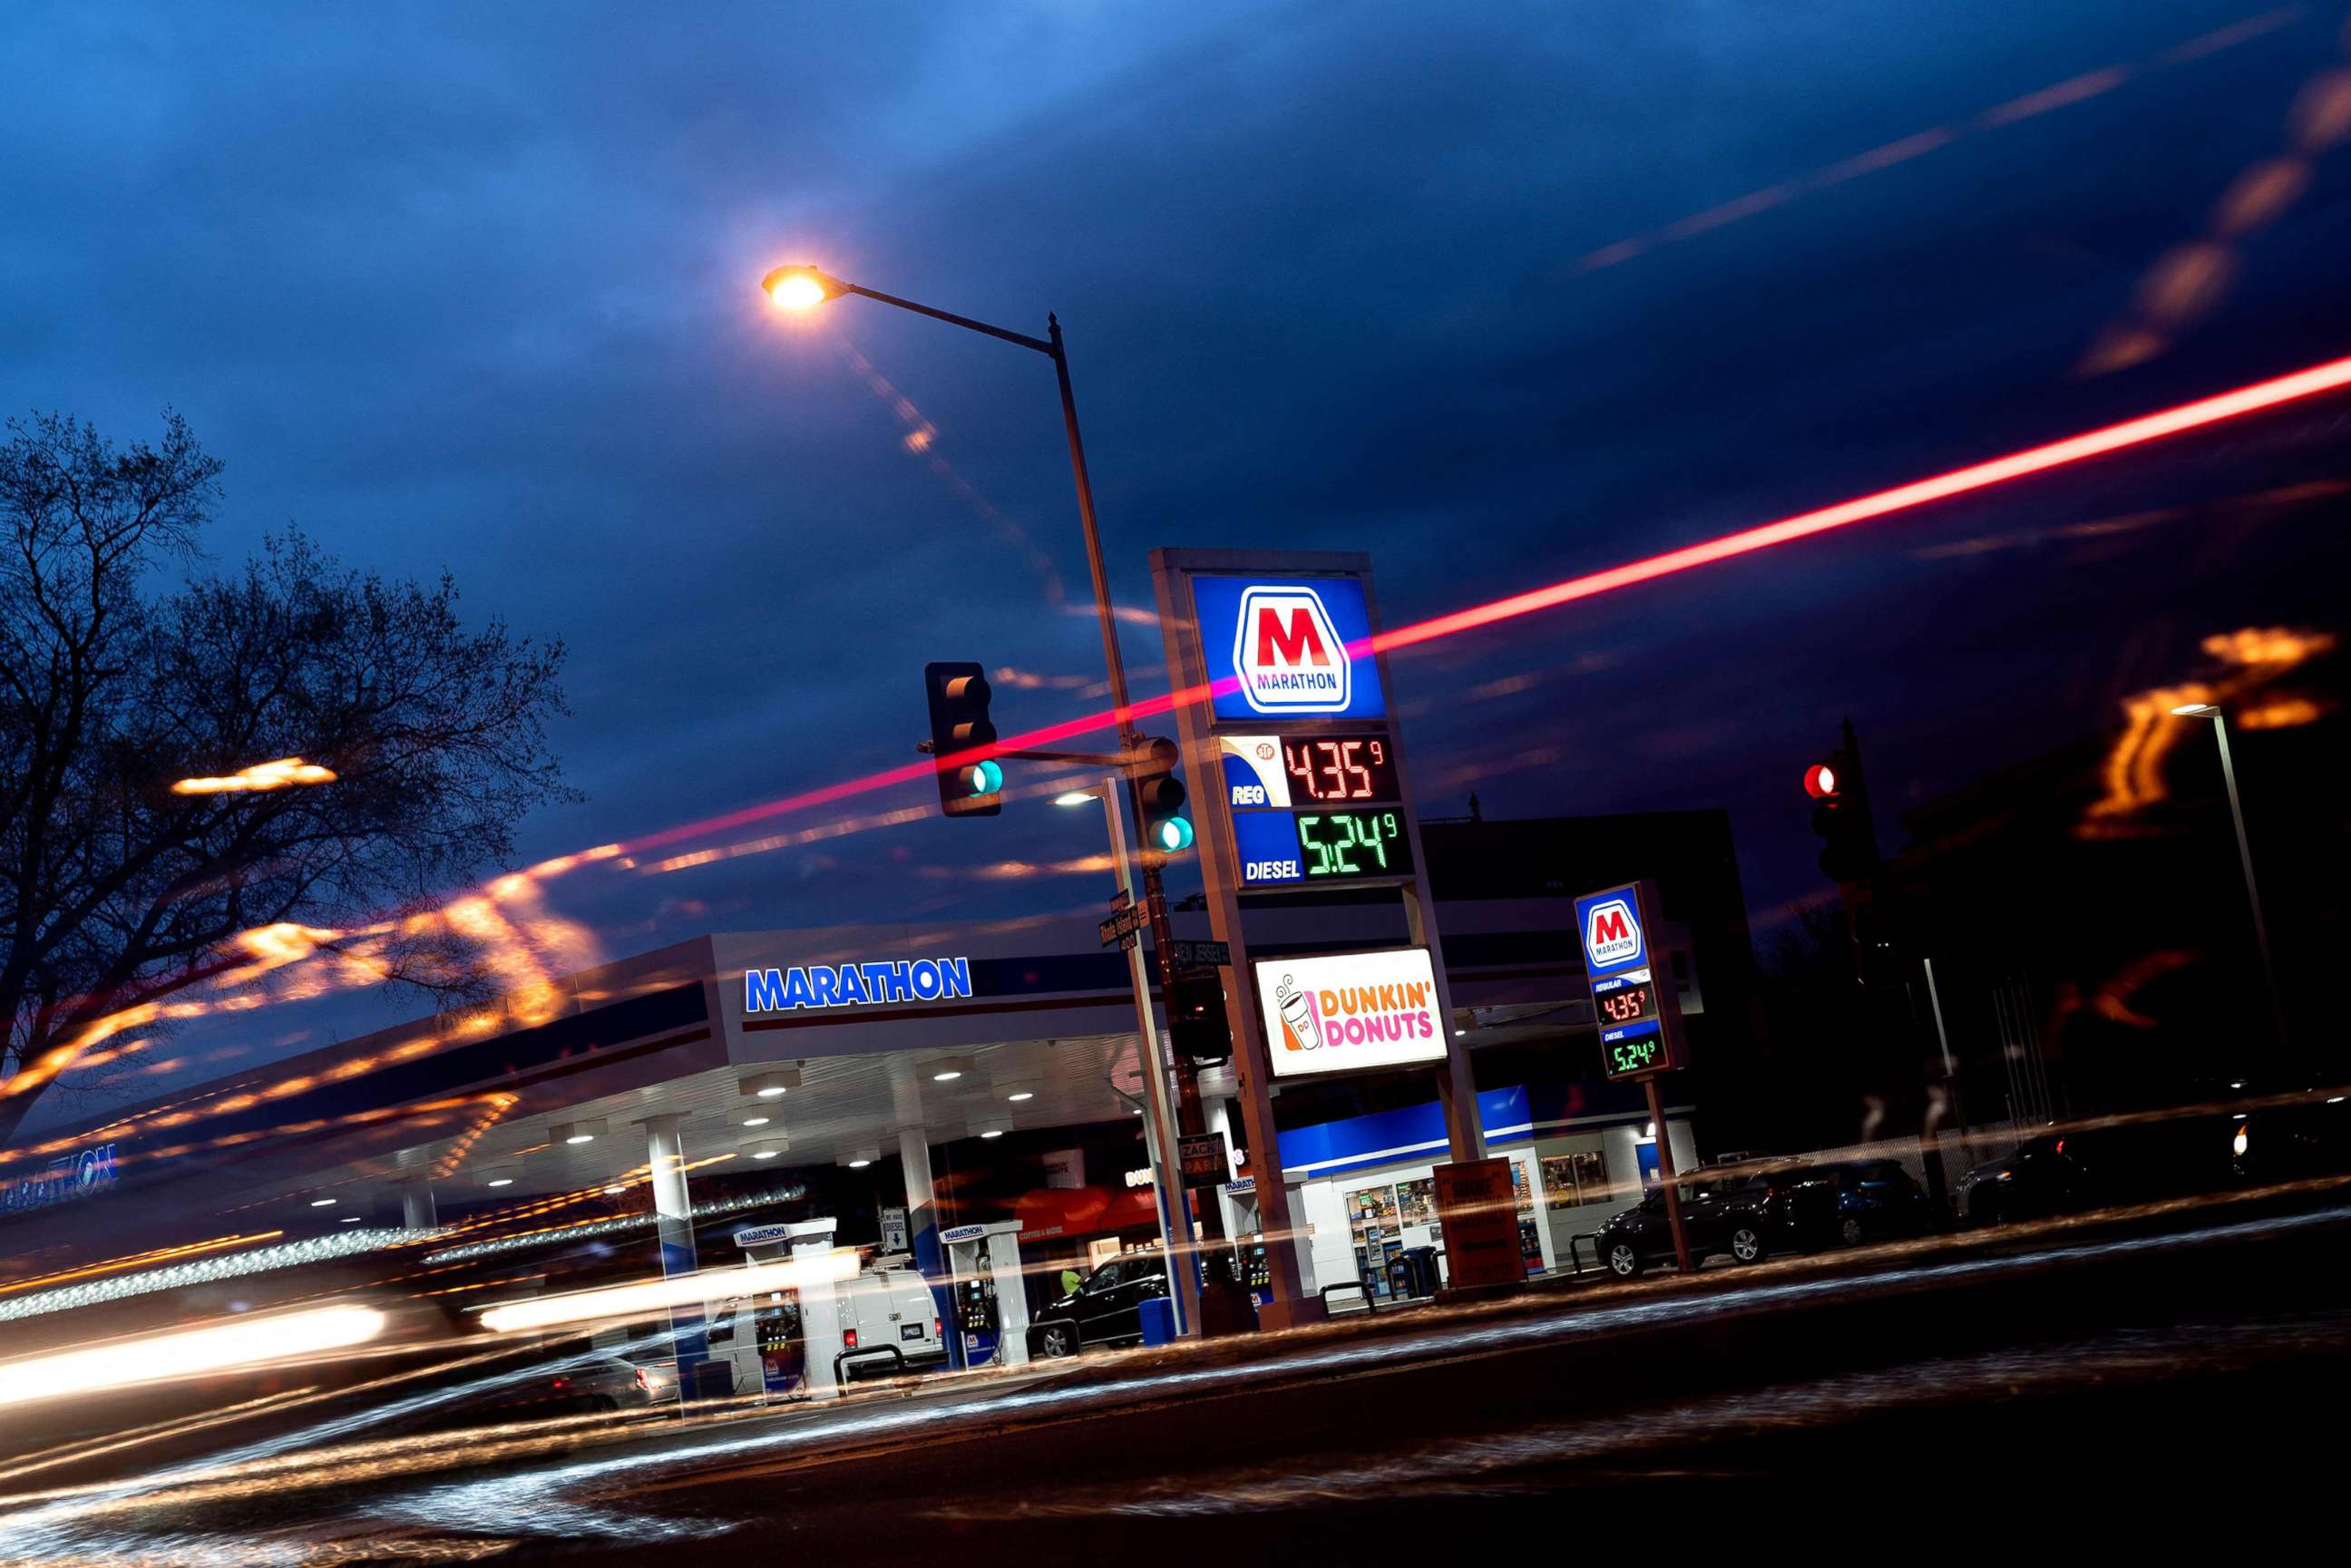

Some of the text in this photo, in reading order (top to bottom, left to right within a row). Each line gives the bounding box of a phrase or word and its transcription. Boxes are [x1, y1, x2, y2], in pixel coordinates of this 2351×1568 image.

[1257, 608, 1331, 666] M
[1257, 673, 1337, 690] MARATHON
[1232, 785, 1264, 805] REG
[1246, 860, 1300, 880] DIESEL
[1595, 911, 1629, 945] M
[1595, 938, 1634, 956] MARATHON
[745, 957, 973, 1013] MARATHON
[1319, 980, 1431, 1017] DUNKIN'
[1297, 1019, 1310, 1033] DD
[1324, 1010, 1433, 1047] DONUTS
[1605, 1030, 1624, 1041] DIESEL
[740, 1227, 785, 1242] MARATHON
[944, 1226, 984, 1240] MARATHON
